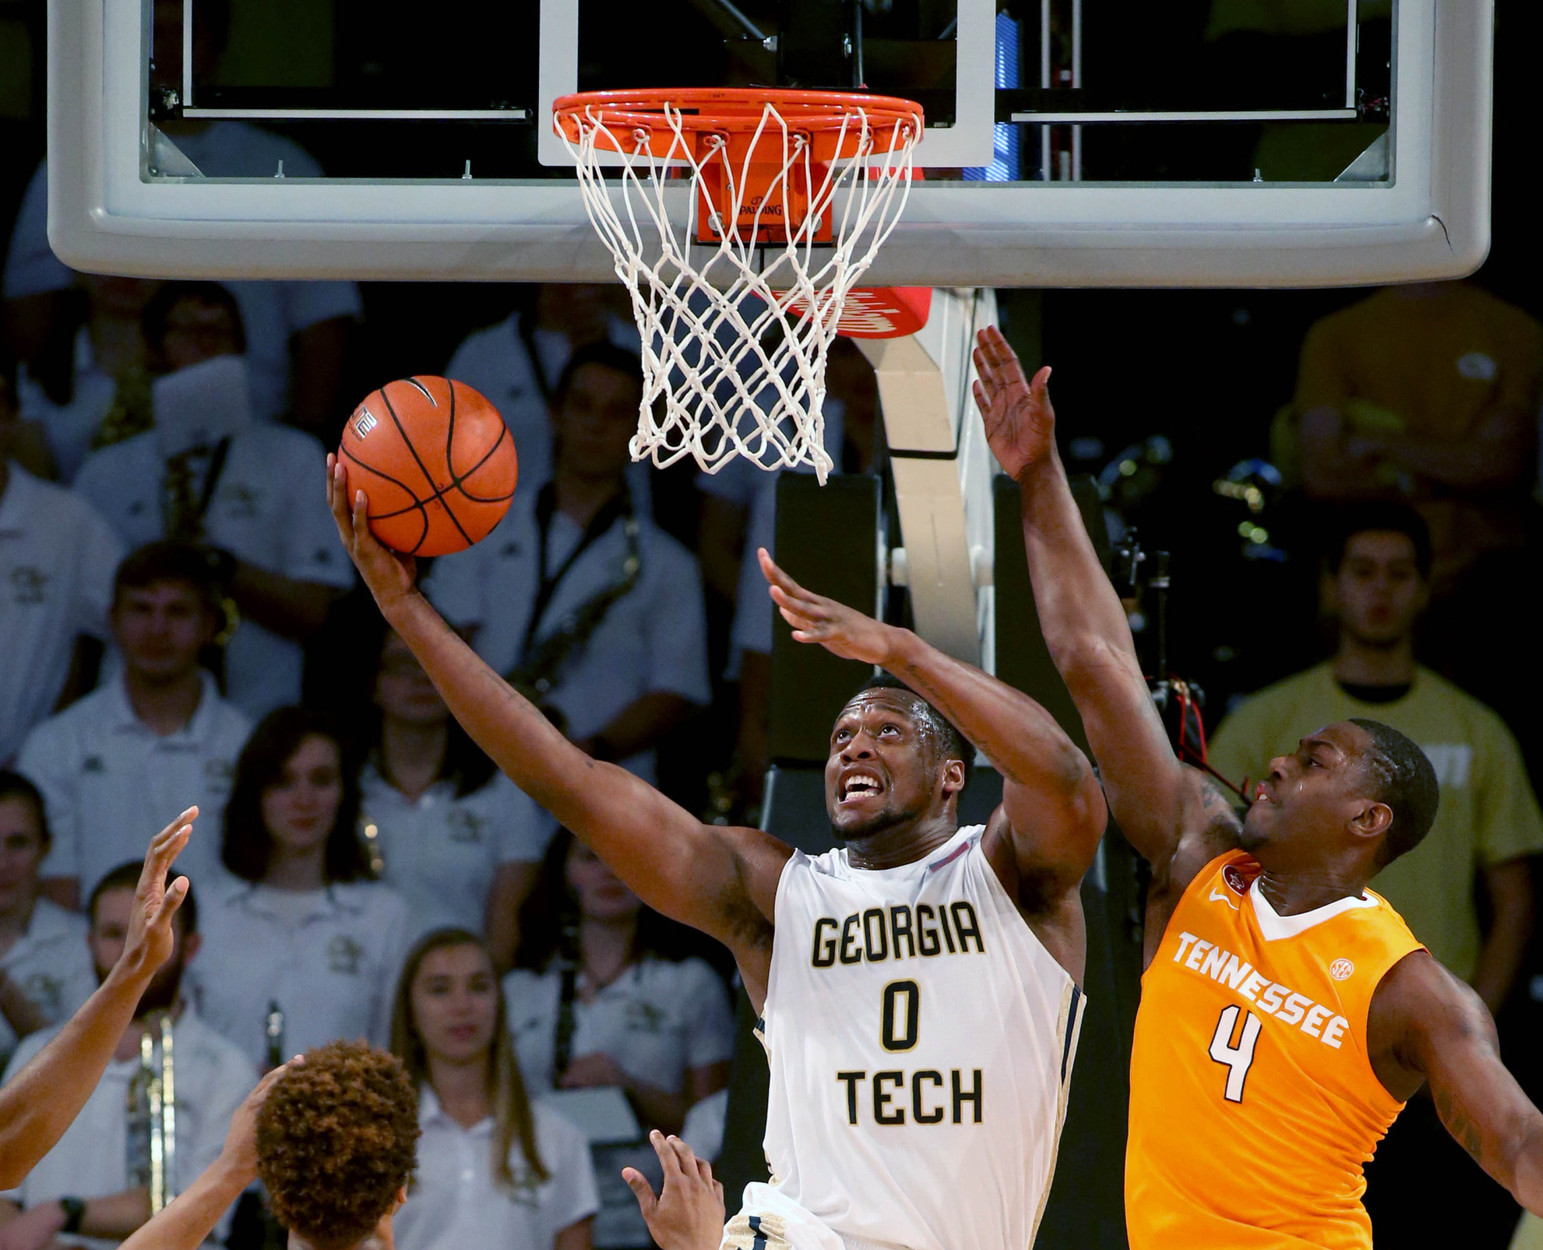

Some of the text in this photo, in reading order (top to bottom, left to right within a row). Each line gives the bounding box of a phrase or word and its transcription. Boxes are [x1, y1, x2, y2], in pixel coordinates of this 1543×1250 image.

[739, 204, 782, 216] PALING
[811, 900, 986, 969] GEORGIA
[879, 978, 921, 1053] 0
[1173, 931, 1350, 1050] TENNESSEE
[1208, 1003, 1263, 1104] 4
[836, 1068, 984, 1126] TECH
